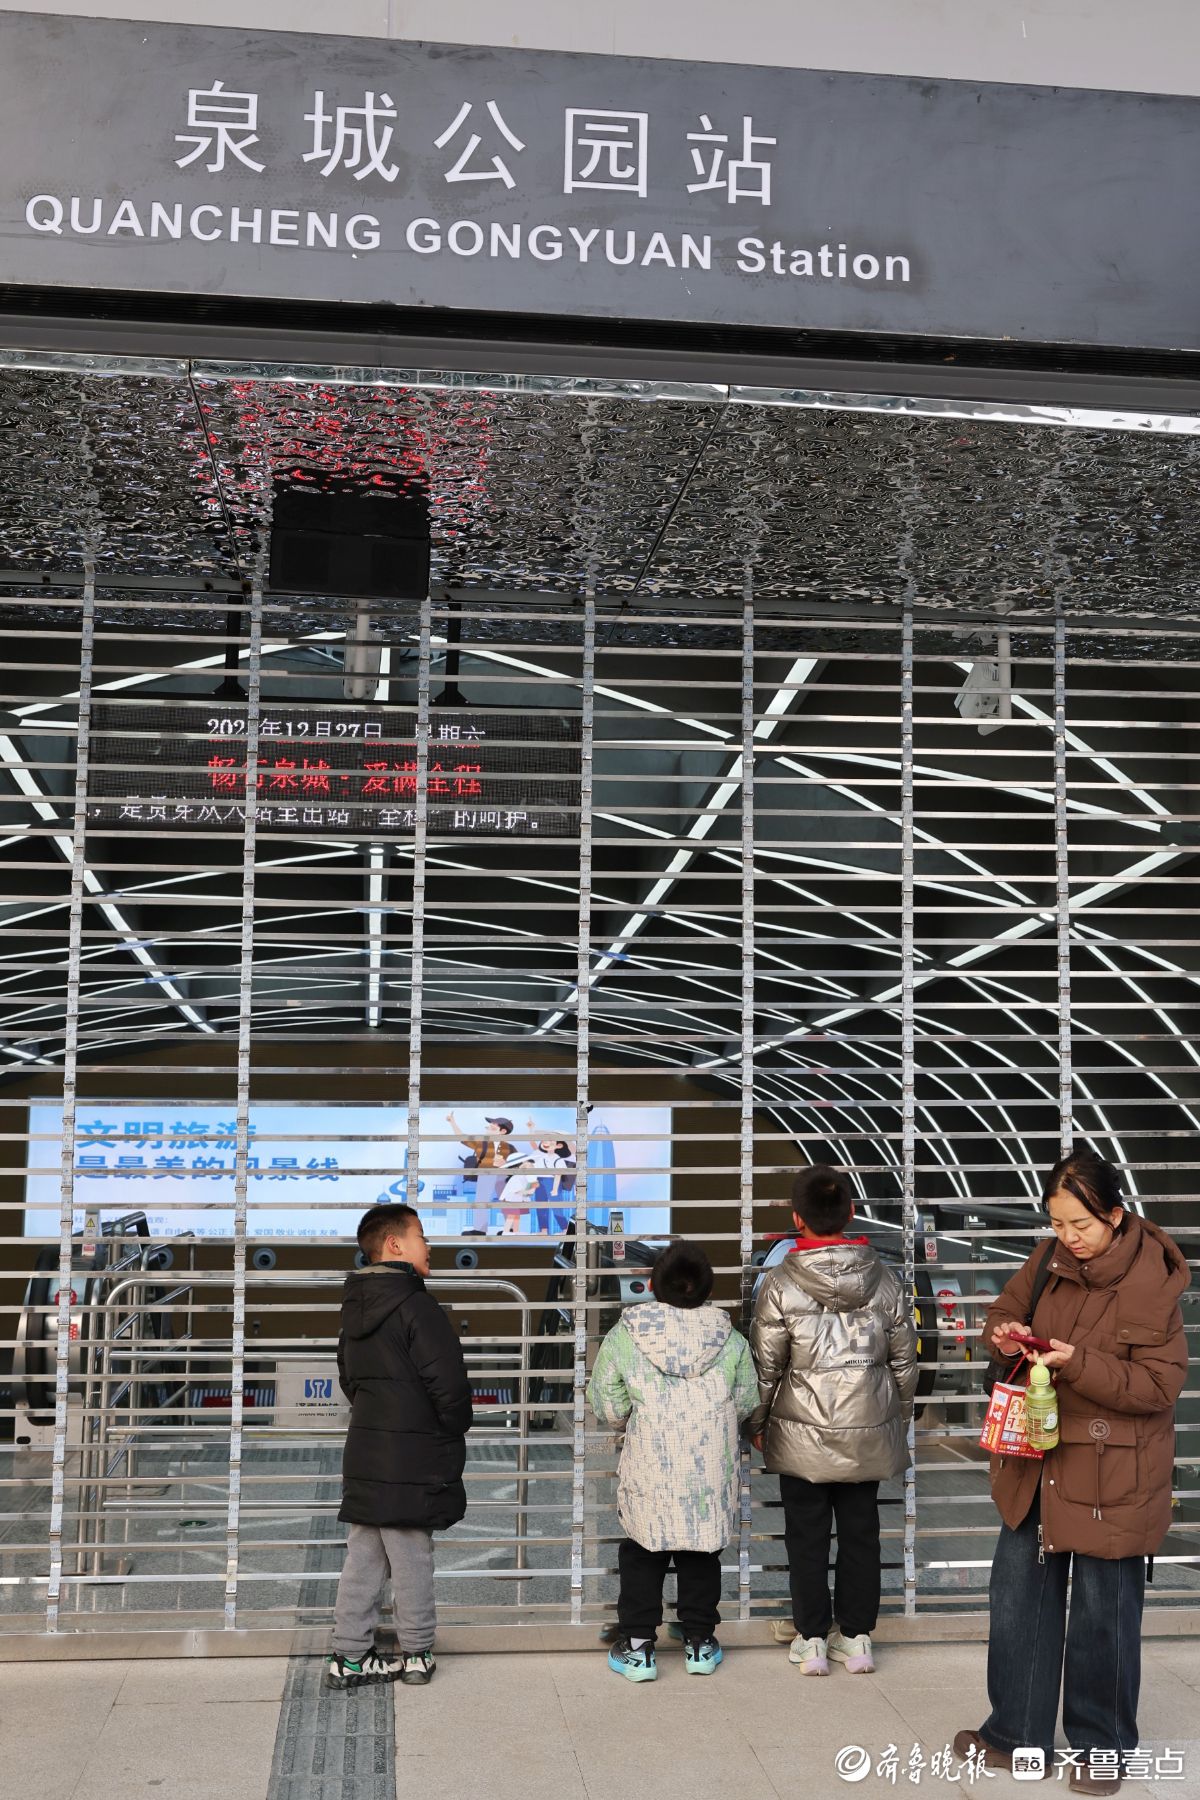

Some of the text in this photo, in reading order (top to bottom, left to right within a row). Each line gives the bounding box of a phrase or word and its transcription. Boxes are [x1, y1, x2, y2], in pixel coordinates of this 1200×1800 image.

[175, 80, 778, 207] 泉城公园站
[25, 194, 911, 282] QUANCHENG GONGYUAN Station
[207, 718, 383, 742] 202年12月27日
[76, 1119, 257, 1151] 文明旅游
[75, 1155, 341, 1182] 是最美的风景线
